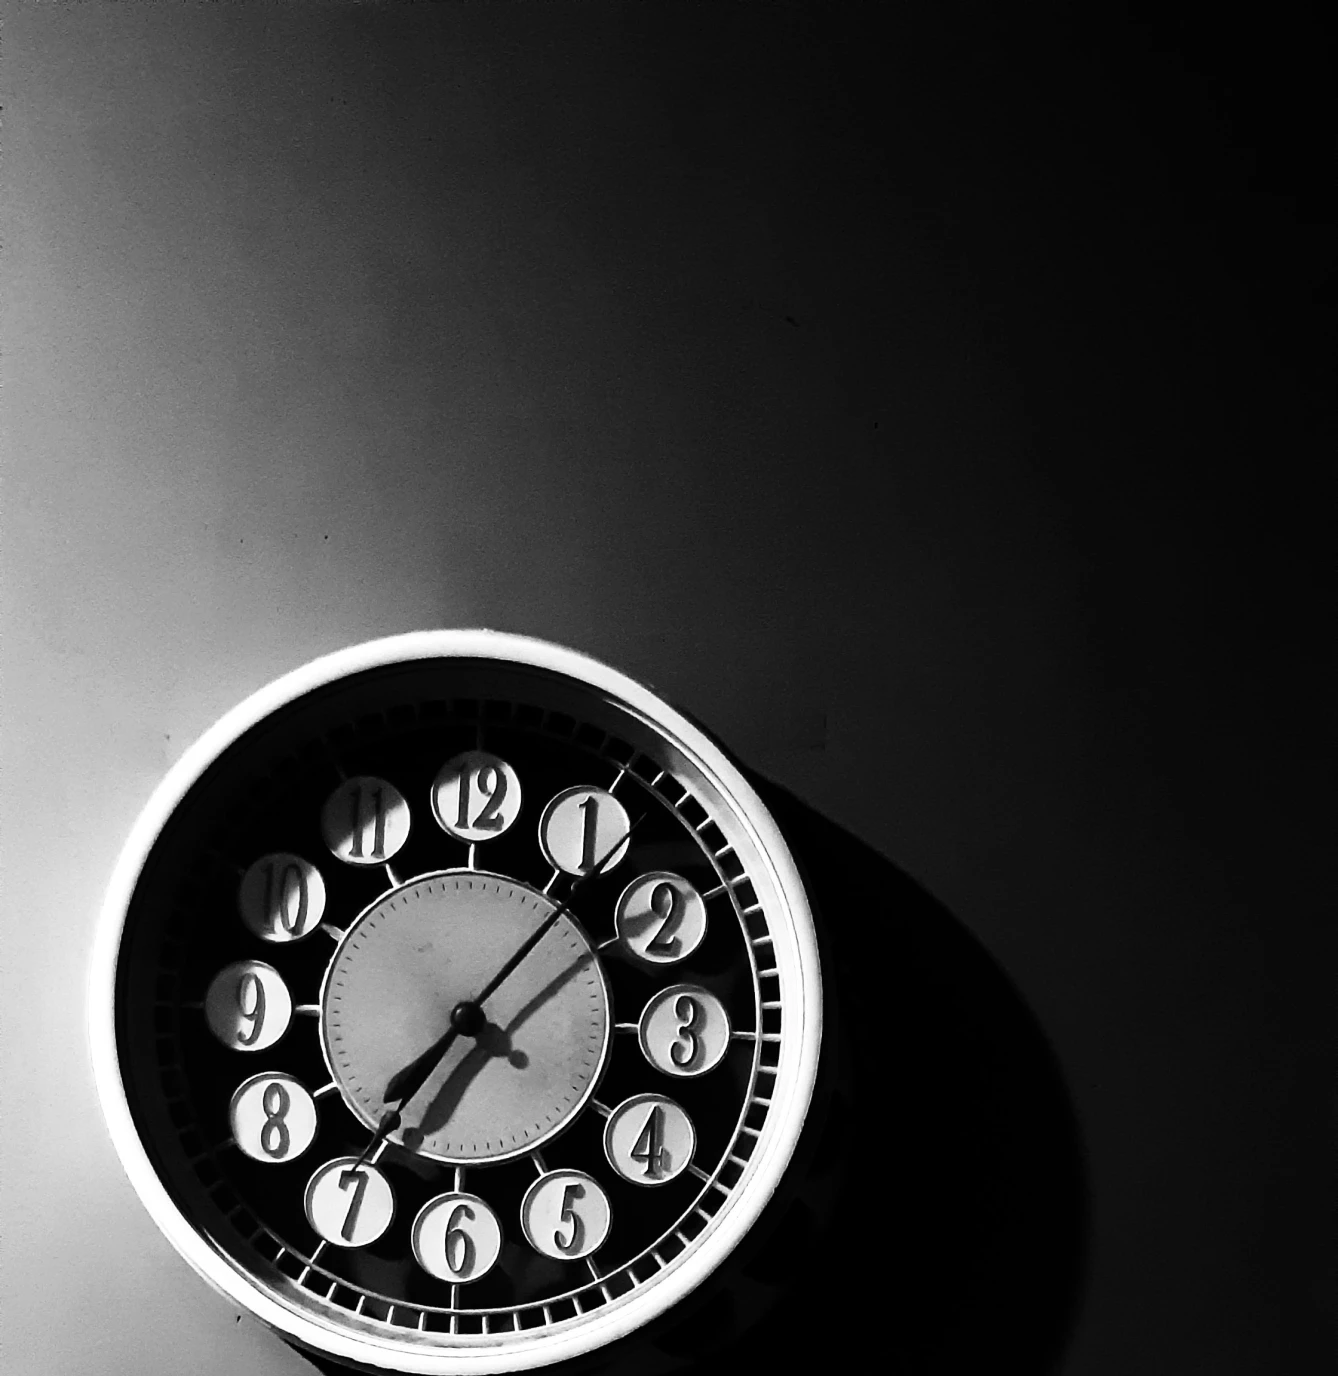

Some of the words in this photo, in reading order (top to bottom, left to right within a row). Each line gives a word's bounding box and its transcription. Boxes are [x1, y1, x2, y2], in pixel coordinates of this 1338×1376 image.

[348, 791, 384, 859] 11
[455, 763, 506, 830] 12
[577, 797, 599, 871] 1
[263, 863, 306, 934] 10
[646, 883, 684, 952] 2
[237, 973, 266, 1044] 9
[669, 996, 699, 1066] 3
[261, 1083, 290, 1157] 8
[631, 1106, 664, 1174] 4
[339, 1170, 368, 1241] 7
[445, 1206, 475, 1272] 6
[554, 1184, 586, 1250] 5
